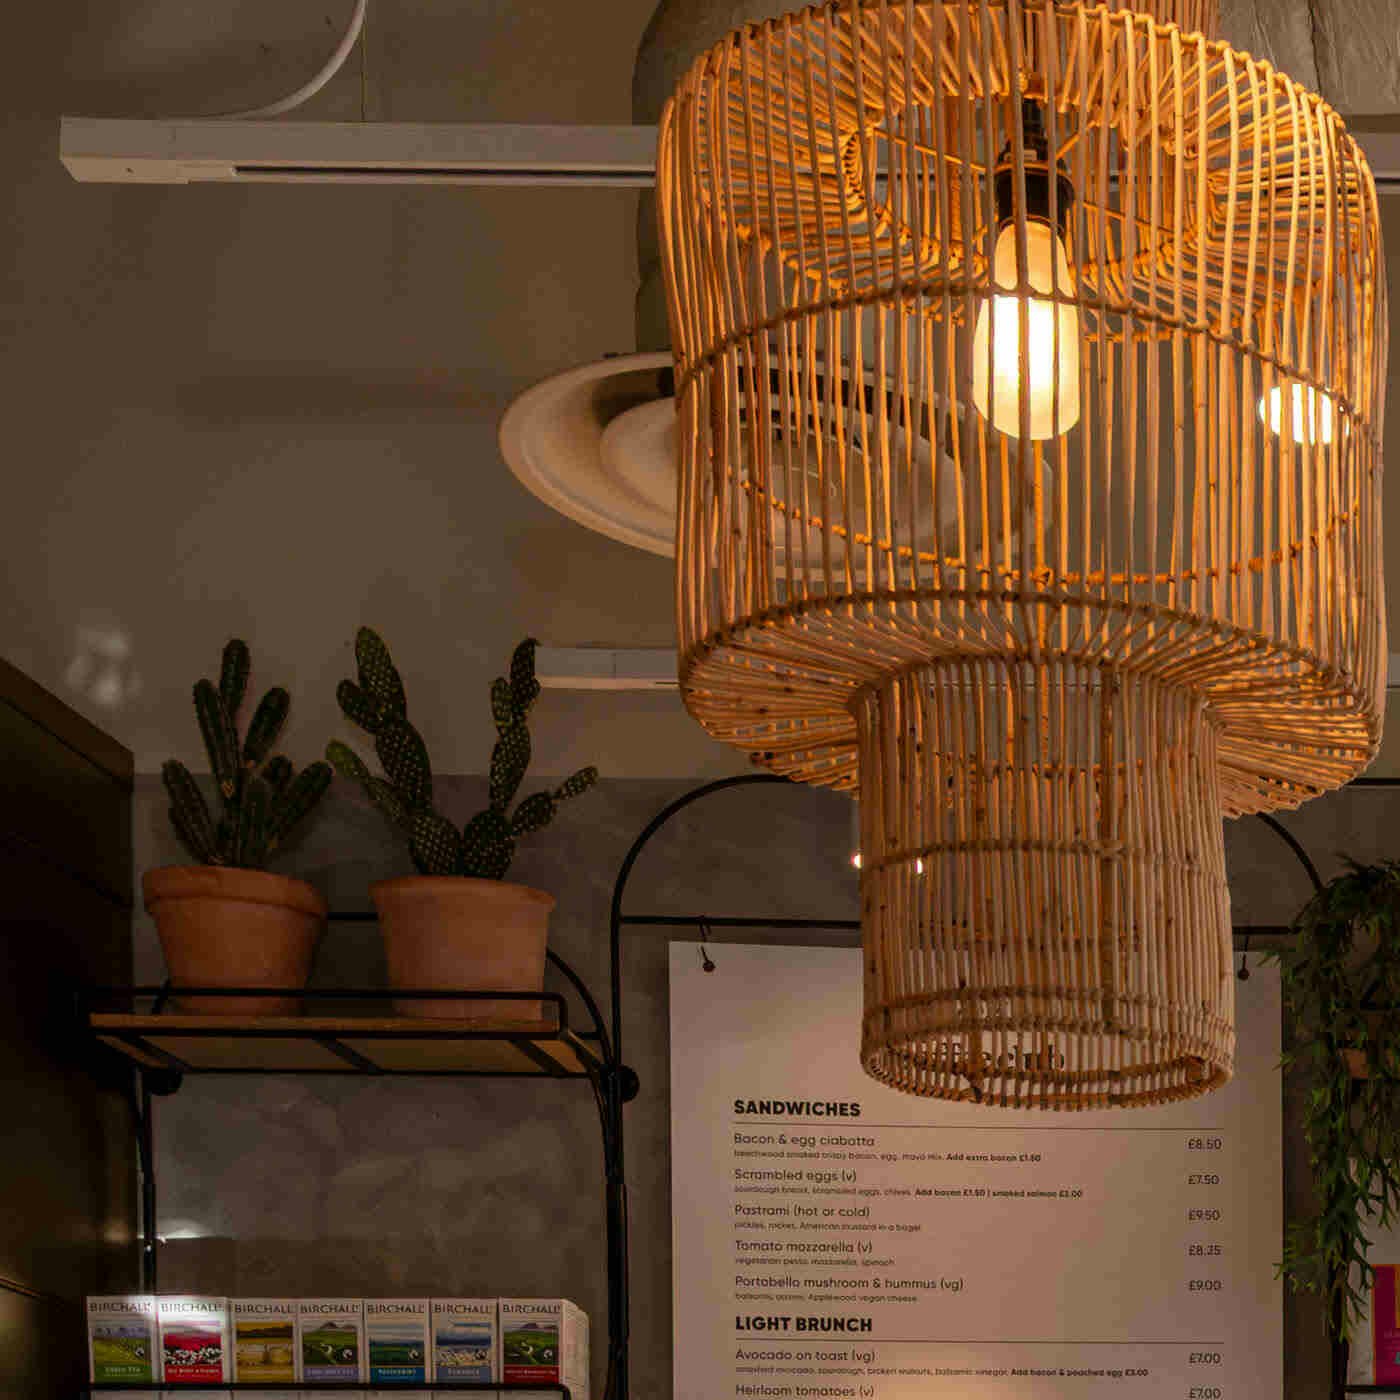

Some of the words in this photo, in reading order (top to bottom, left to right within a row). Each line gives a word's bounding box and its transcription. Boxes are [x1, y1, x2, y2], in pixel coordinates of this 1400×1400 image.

[734, 1100, 861, 1116] SANDWICHES
[734, 1134, 774, 1144] Bacon
[779, 1135, 787, 1145] &
[791, 1136, 816, 1147] egg
[820, 1135, 875, 1146] ciabatta
[1188, 1139, 1222, 1150] £8.50
[735, 1169, 802, 1180] Scrambled
[807, 1171, 838, 1183] eggs
[842, 1170, 857, 1182] (v)
[1188, 1175, 1219, 1185] £7.50
[735, 1205, 790, 1216] Pastrami
[794, 1206, 818, 1217] (hot
[822, 1208, 834, 1217] or
[838, 1207, 870, 1218] cold)
[736, 1241, 783, 1251] Tomato
[786, 1242, 854, 1253] mozzarella
[857, 1242, 872, 1253] (v)
[735, 1276, 800, 1287] Portobello
[804, 1278, 869, 1288] mushroom
[873, 1279, 881, 1288] &
[885, 1278, 936, 1289] hummus
[940, 1278, 963, 1291] (vg)
[1189, 1280, 1222, 1291] £9.00
[736, 1317, 790, 1331] LIGHT
[796, 1318, 872, 1332] BRUNCH
[736, 1349, 792, 1360] Avocado
[796, 1352, 811, 1360] on
[816, 1351, 848, 1361] toast
[852, 1350, 876, 1363] (vg)
[736, 1385, 792, 1396] Heirloom
[796, 1386, 855, 1396] tomatoes
[859, 1386, 874, 1398] (v)
